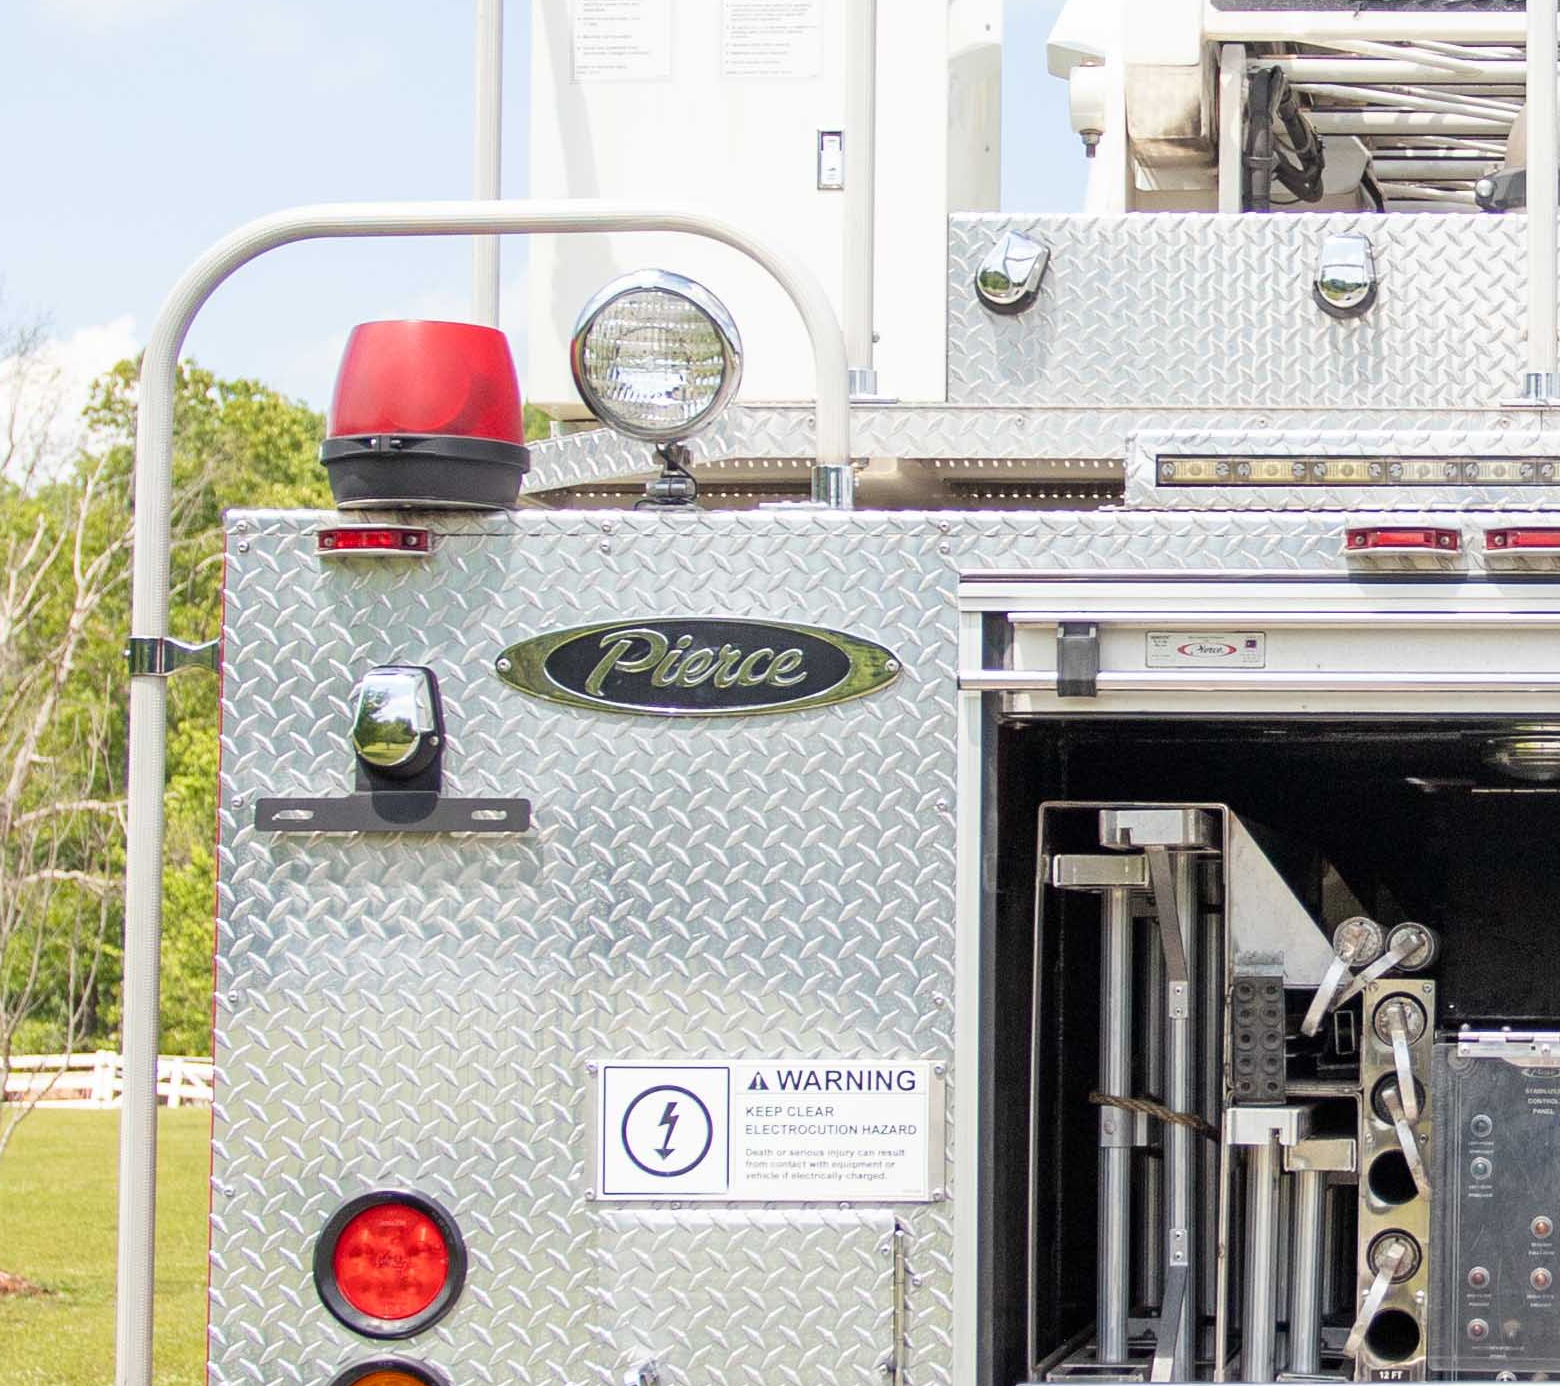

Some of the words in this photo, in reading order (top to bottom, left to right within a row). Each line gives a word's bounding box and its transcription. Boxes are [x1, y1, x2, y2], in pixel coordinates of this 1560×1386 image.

[584, 628, 807, 697] Pierce
[776, 1069, 917, 1092] WARNING
[1527, 1097, 1559, 1105] CONTROL
[745, 1106, 783, 1118] KEEP
[787, 1106, 834, 1118] CLEAR
[745, 1124, 858, 1135] ELECTROCUTION
[862, 1124, 917, 1135] HAZARD
[745, 1148, 773, 1157] Death
[790, 1148, 824, 1157] serious
[827, 1148, 855, 1159] injury
[877, 1149, 905, 1157] result
[745, 1160, 768, 1169] from
[770, 1160, 807, 1169] contact
[809, 1160, 829, 1169] with
[831, 1160, 882, 1171] equipment
[884, 1161, 896, 1169] or
[745, 1171, 780, 1180] vehicle
[782, 1171, 789, 1180] if
[791, 1171, 842, 1181] electrically
[1379, 1370, 1390, 1380] 12
[1391, 1370, 1403, 1380] FT
